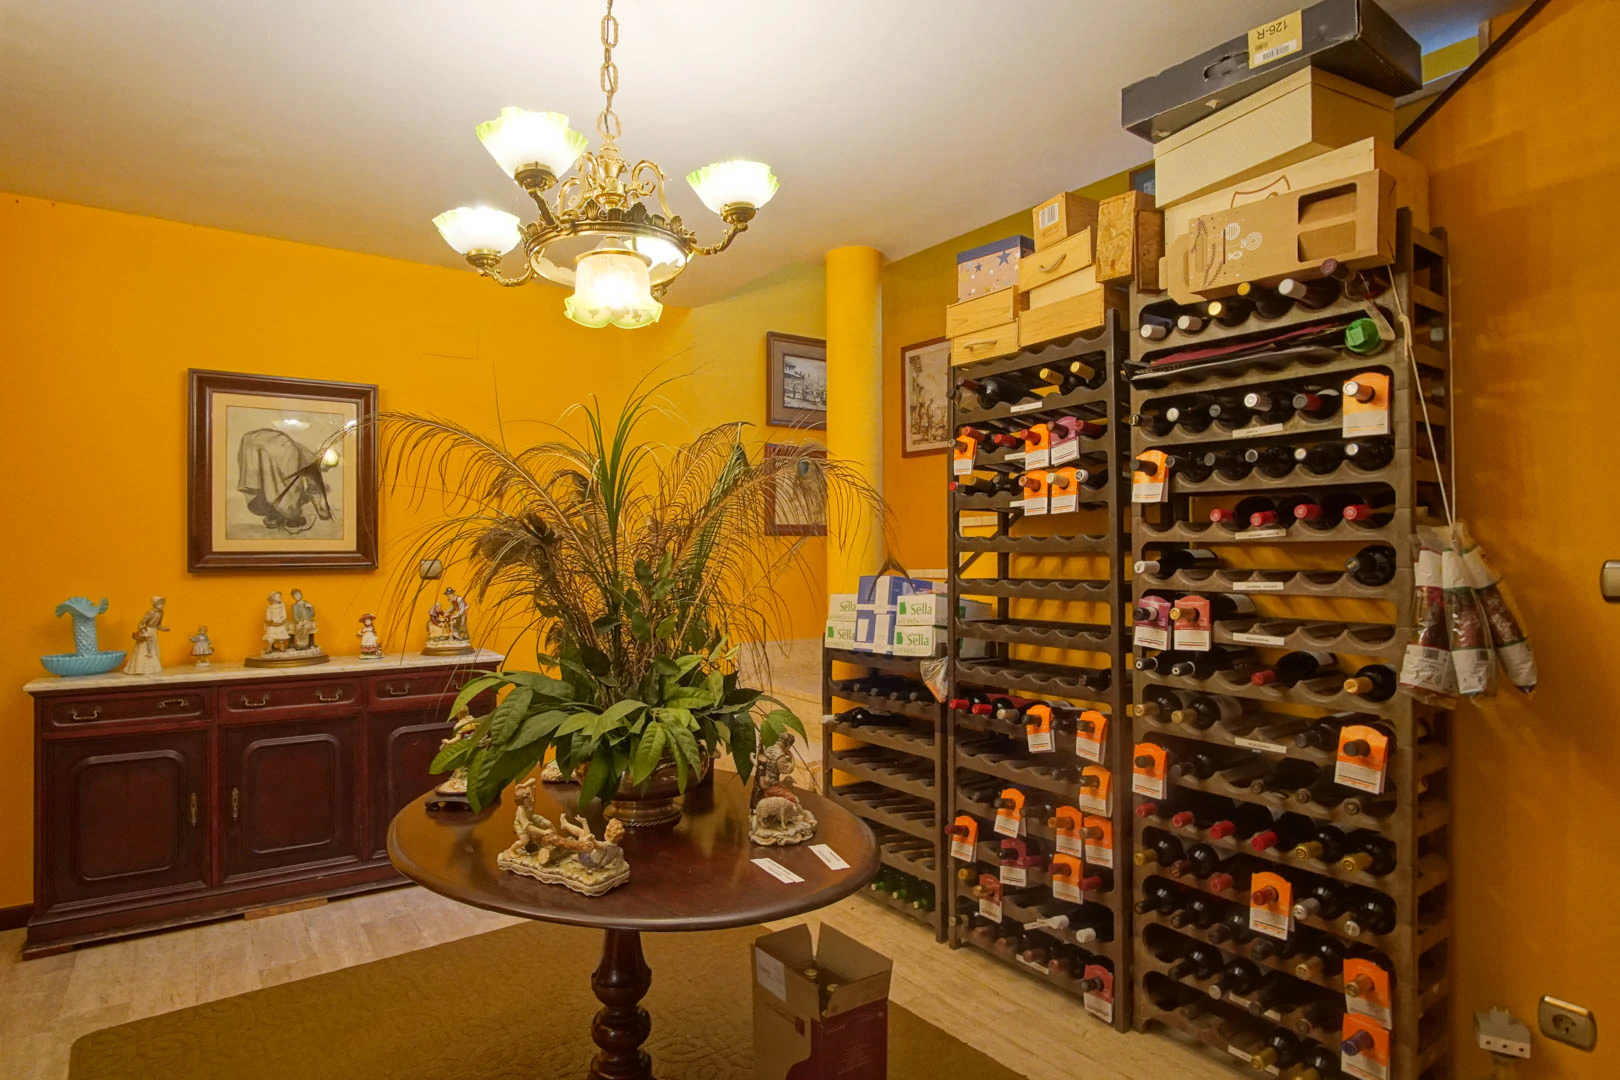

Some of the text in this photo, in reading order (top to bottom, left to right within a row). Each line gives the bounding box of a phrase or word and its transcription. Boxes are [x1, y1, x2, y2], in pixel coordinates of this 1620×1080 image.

[1256, 20, 1289, 40] 126-R
[911, 602, 932, 615] Sella
[907, 633, 930, 646] Sella
